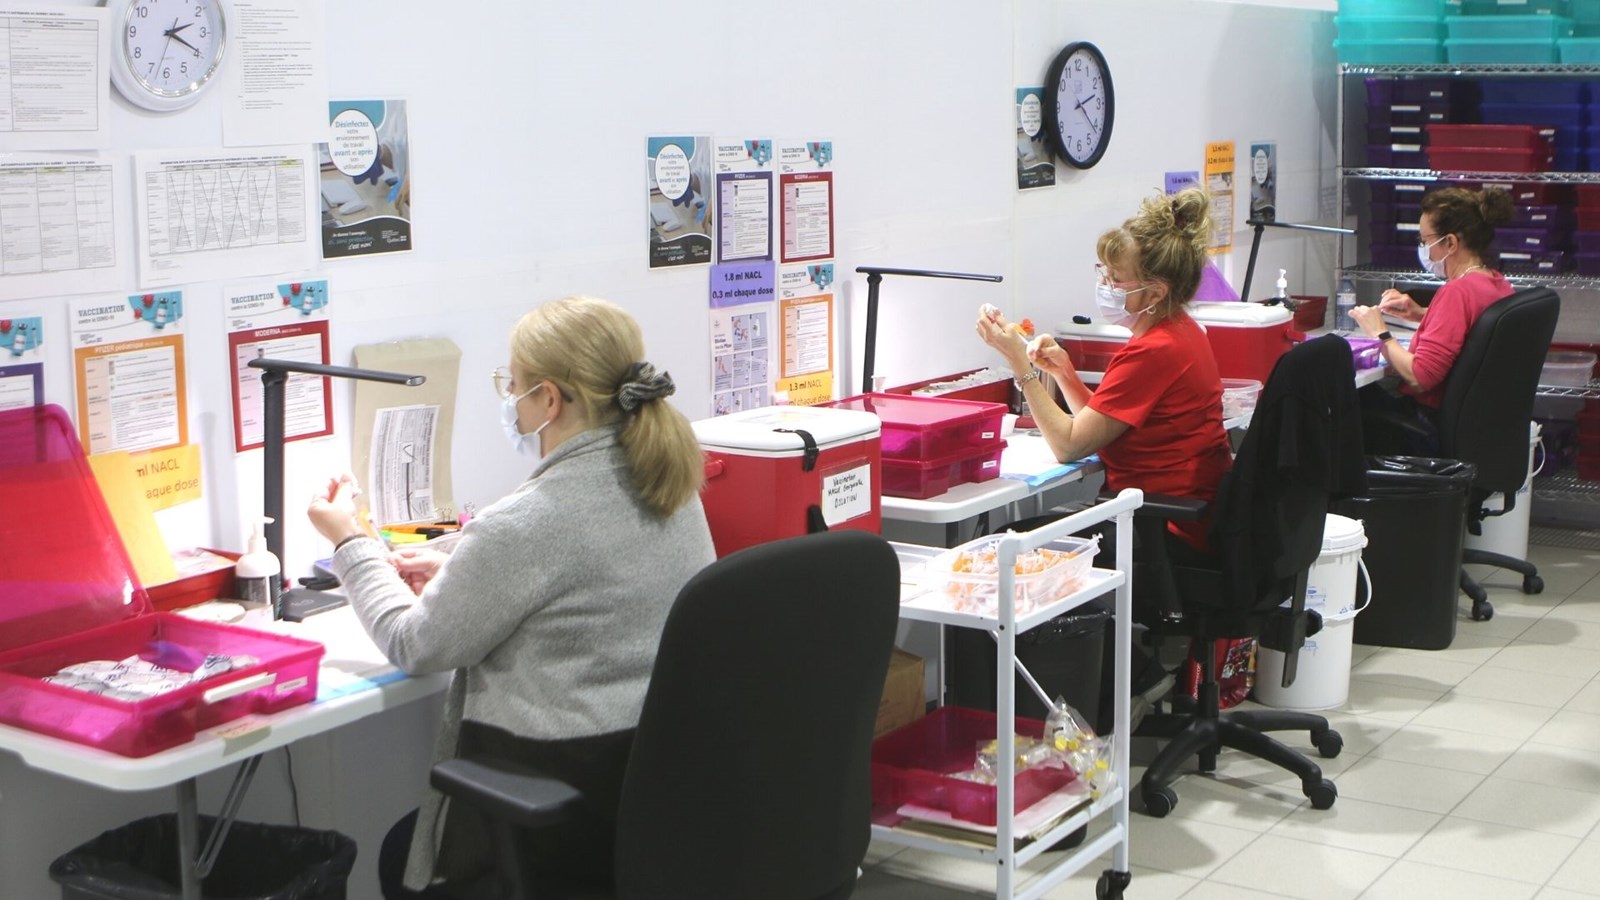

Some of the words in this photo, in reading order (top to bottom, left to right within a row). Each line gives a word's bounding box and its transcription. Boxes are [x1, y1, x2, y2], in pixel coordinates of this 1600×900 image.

[136, 6, 148, 18] 10
[194, 6, 202, 17] 2
[129, 26, 136, 38] 9
[200, 26, 206, 38] 3
[134, 47, 141, 58] 8
[193, 48, 200, 59] 4
[148, 62, 155, 74] 7
[180, 62, 187, 73] 5
[1074, 59, 1081, 71] 12
[163, 67, 170, 78] 6
[1065, 66, 1072, 78] 11
[1086, 66, 1089, 77] 1
[1093, 77, 1097, 90] 2
[1096, 97, 1101, 110] 3
[1060, 121, 1064, 134] 8
[1094, 118, 1098, 129] 4
[1067, 135, 1072, 148] 7
[1087, 133, 1091, 146] 5
[1077, 140, 1082, 152] 6
[724, 272, 734, 282] 1.8
[735, 272, 743, 280] ml
[745, 271, 762, 280] NACL
[231, 293, 274, 304] VACCINATION
[712, 290, 723, 299] 0.3
[725, 289, 732, 298] ml
[734, 288, 756, 298] chaque
[758, 287, 773, 295] dose
[78, 305, 125, 317] VACCINATION
[254, 328, 280, 337] MODERNA
[790, 383, 798, 391] 1.3
[799, 381, 806, 389] ml
[808, 379, 822, 388] NACL
[151, 458, 180, 474] NACL
[146, 484, 172, 499] aque
[175, 478, 199, 491] dose
